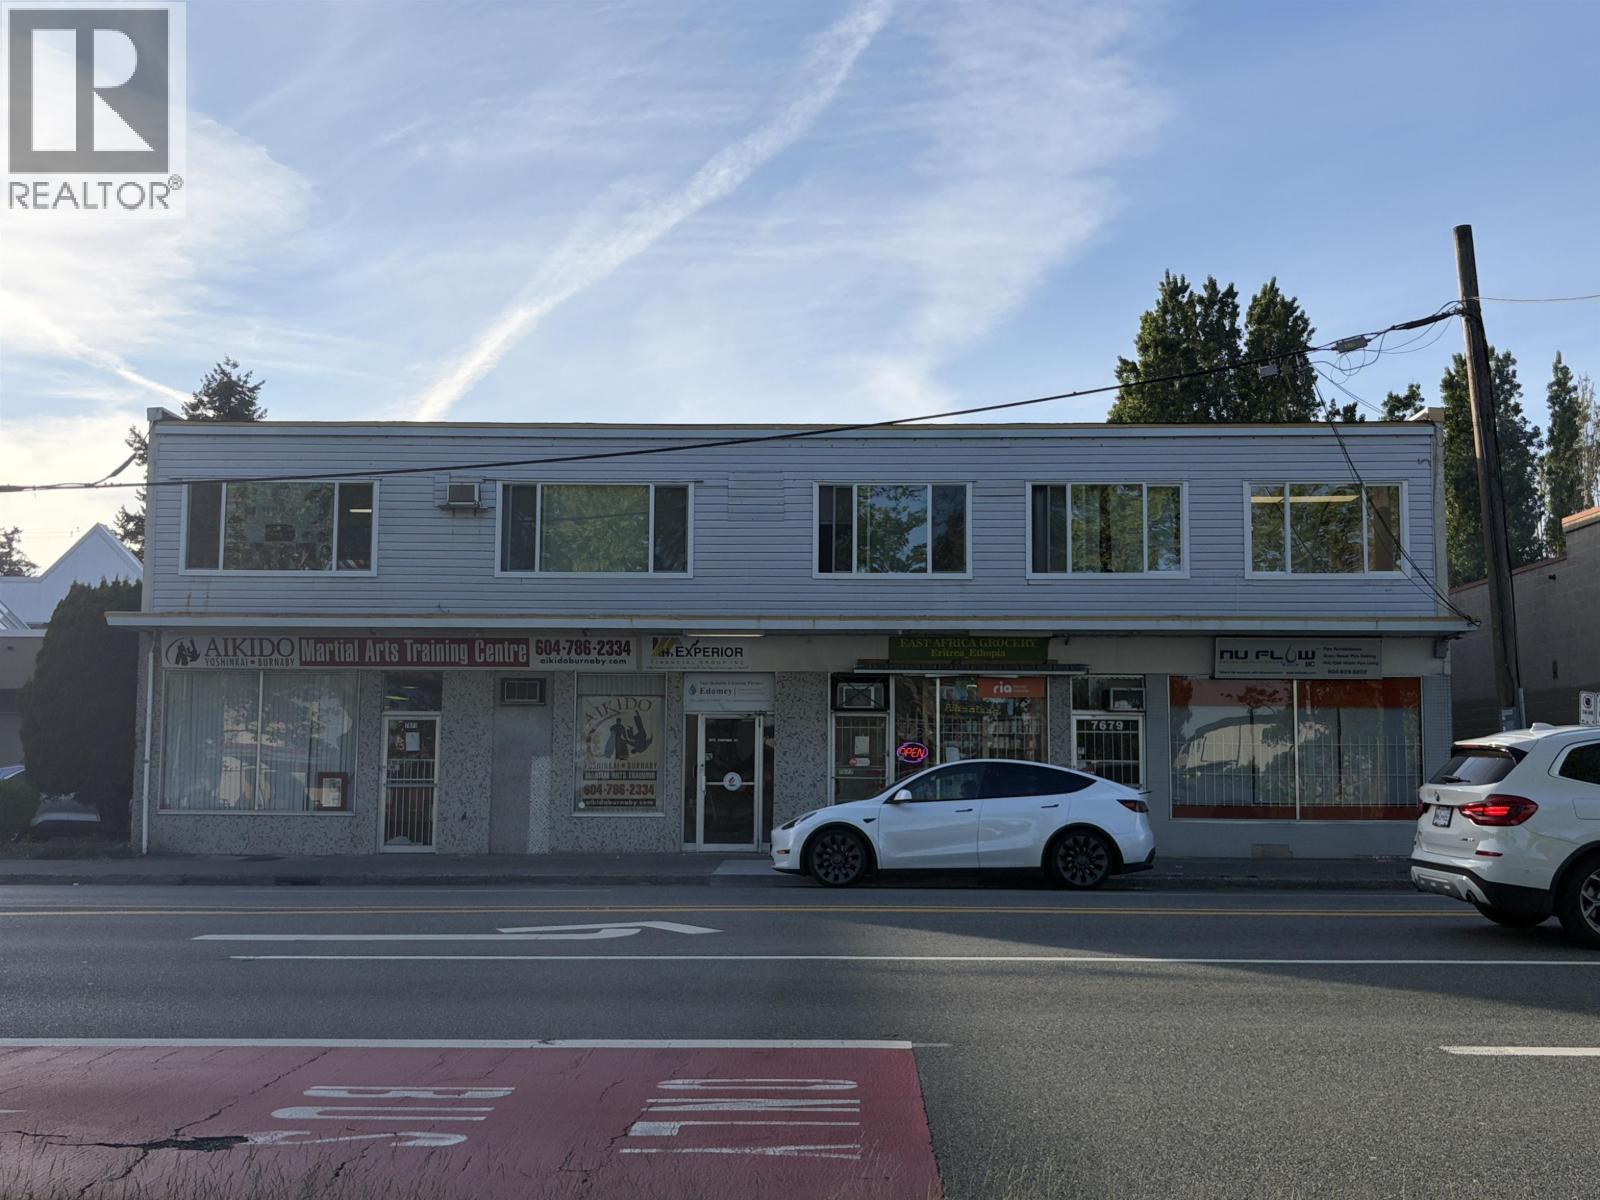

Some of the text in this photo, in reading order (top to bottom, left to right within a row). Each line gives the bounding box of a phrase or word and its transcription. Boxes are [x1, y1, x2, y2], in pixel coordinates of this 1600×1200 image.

[205, 637, 295, 657] AIKIDO
[900, 639, 1035, 647] EAST AFRICA GROCERY
[302, 640, 527, 665] Martial Arts Training Centre
[675, 642, 744, 657] EXPERIOR
[258, 657, 295, 669] BURNABY
[540, 657, 627, 666] aikidoburnaby.com
[993, 681, 1013, 693] ria
[585, 697, 652, 719] AIKIDO
[1090, 720, 1124, 731] 7679
[900, 747, 925, 758] OPEN
